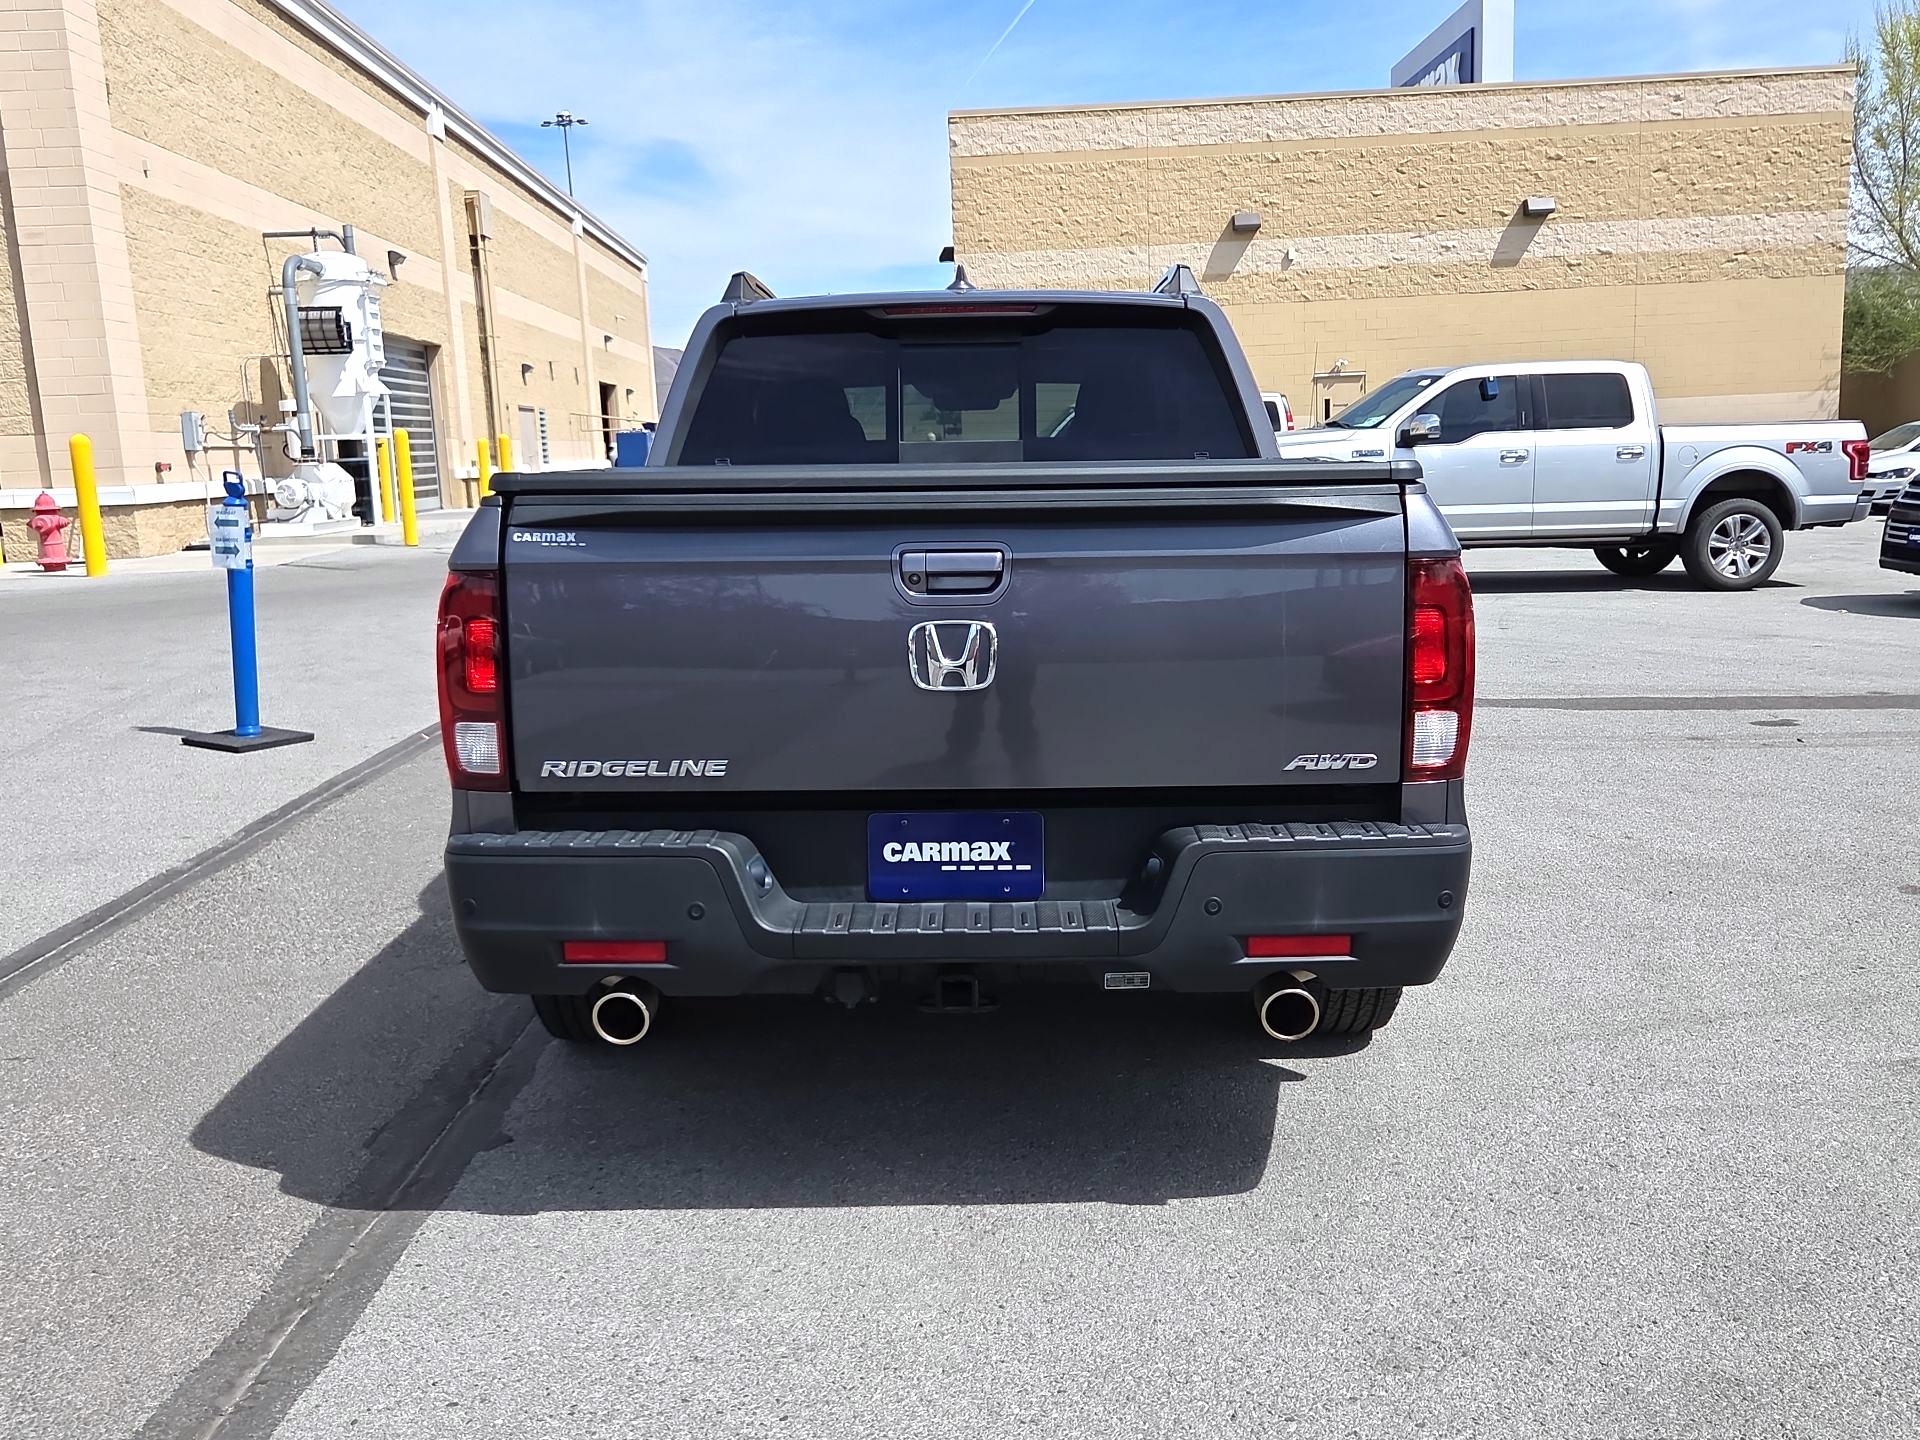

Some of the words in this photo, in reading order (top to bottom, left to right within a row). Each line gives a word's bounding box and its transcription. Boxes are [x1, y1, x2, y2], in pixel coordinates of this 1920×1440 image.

[1785, 441, 1832, 454] FX4
[513, 532, 576, 542] CARmax
[540, 760, 729, 778] RIDGELINE
[1282, 753, 1378, 771] AWD
[882, 841, 1012, 863] CARmax
